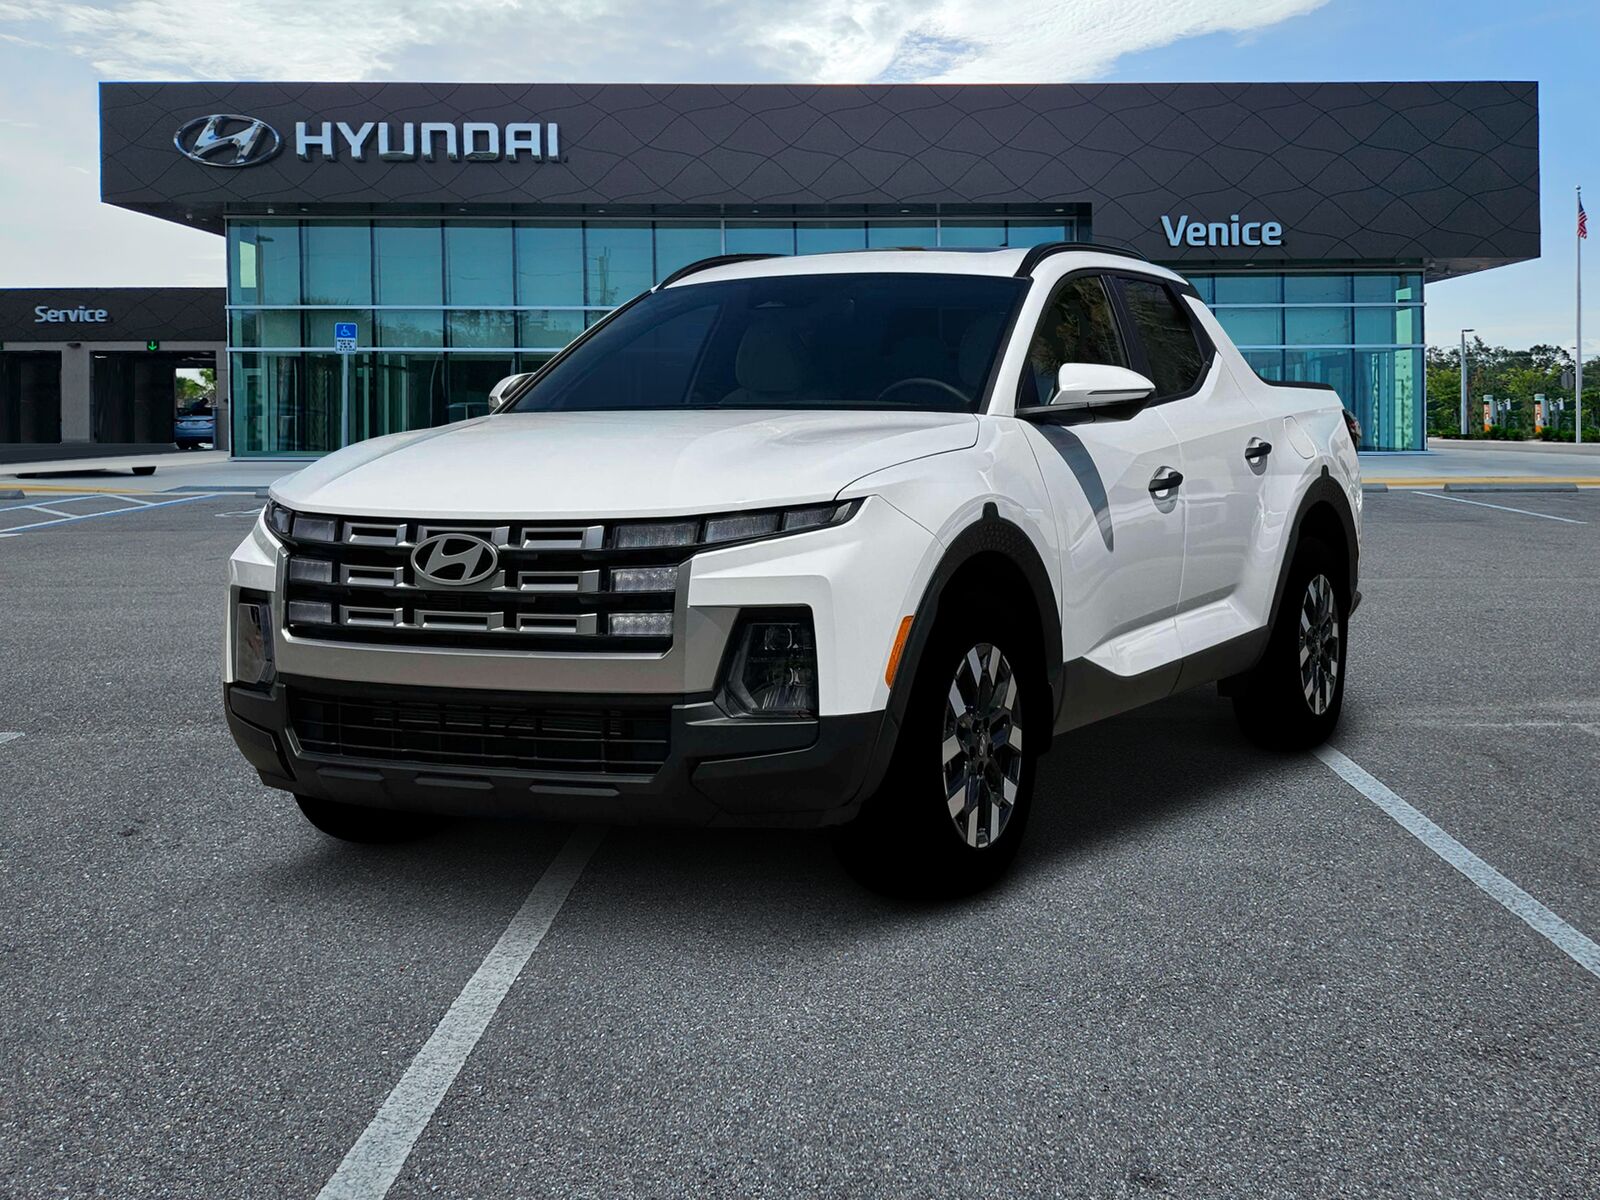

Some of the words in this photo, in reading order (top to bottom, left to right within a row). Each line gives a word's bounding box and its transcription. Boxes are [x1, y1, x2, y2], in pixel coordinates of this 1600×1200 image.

[294, 121, 560, 162] HYUNDAI
[1160, 214, 1283, 247] Venice
[34, 305, 108, 323] Service
